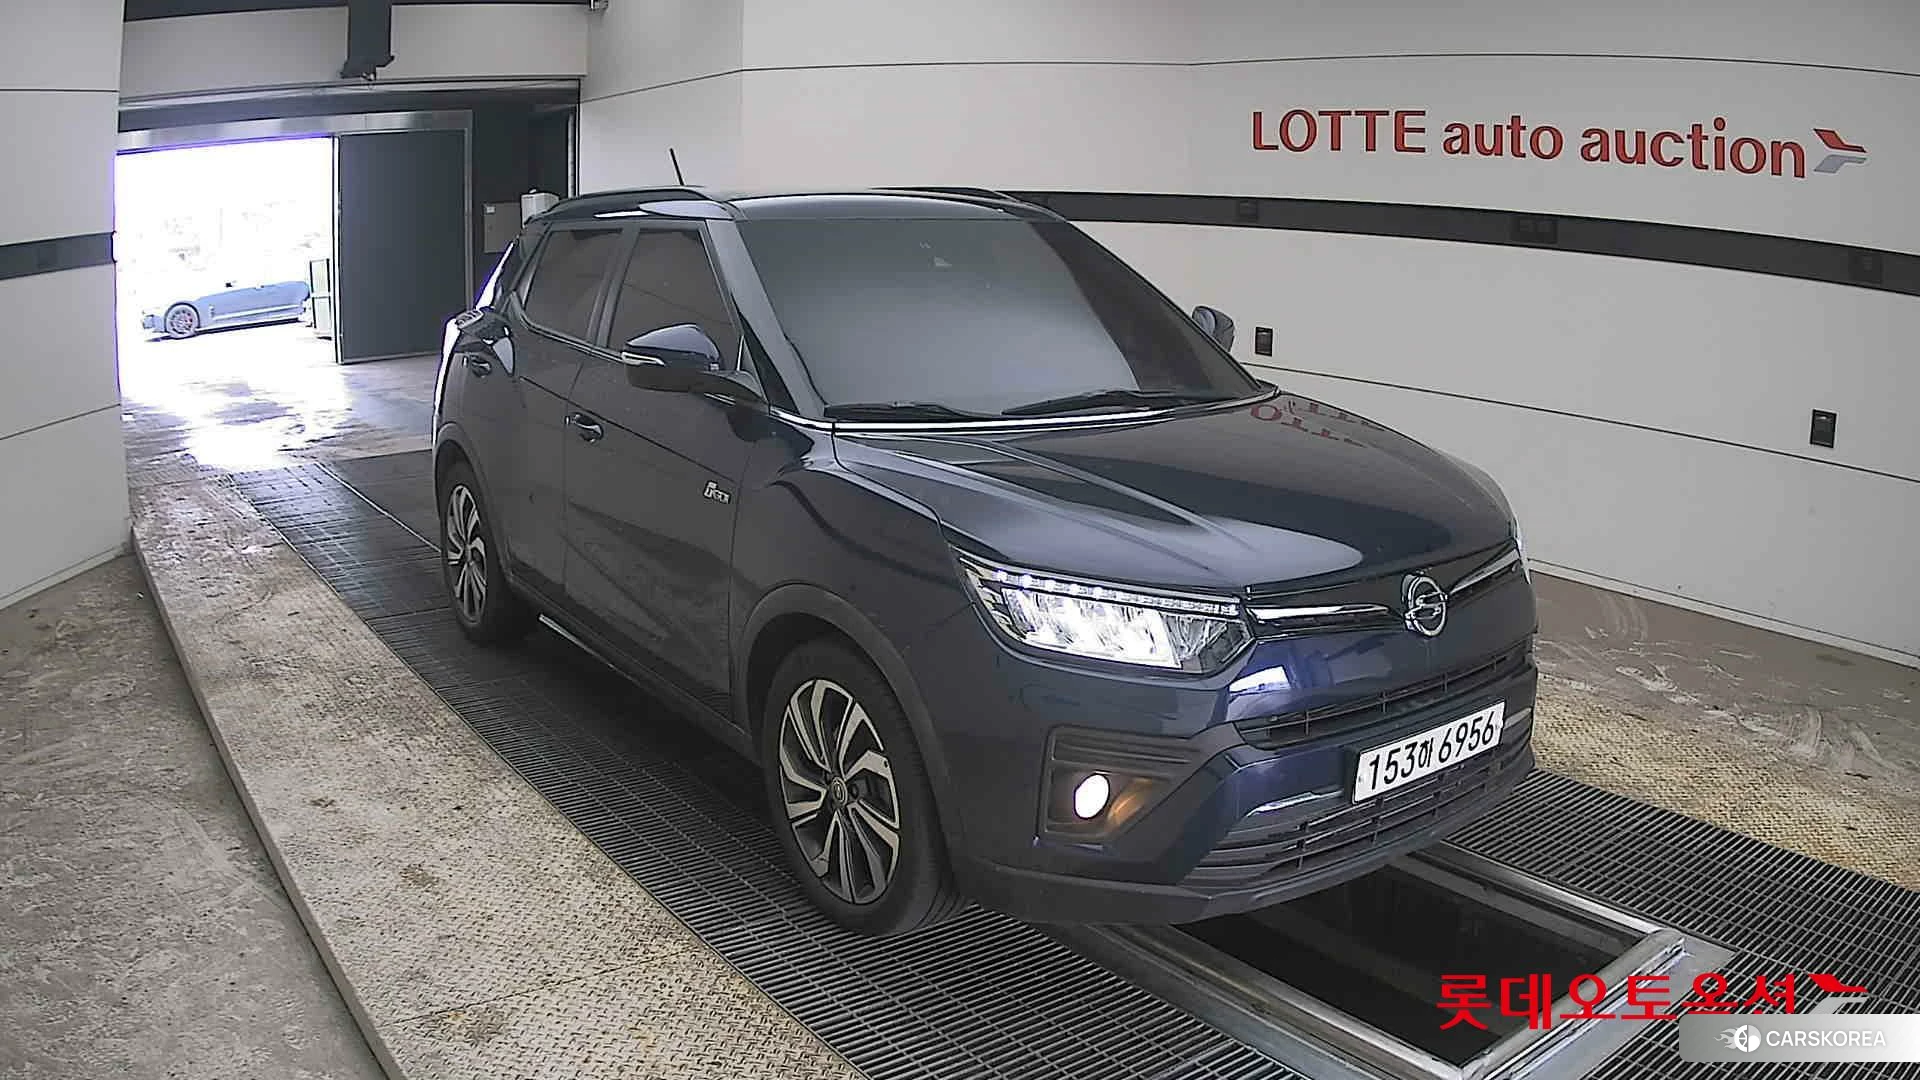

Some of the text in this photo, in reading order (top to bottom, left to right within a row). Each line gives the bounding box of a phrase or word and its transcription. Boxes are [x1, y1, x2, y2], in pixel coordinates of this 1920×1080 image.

[1252, 109, 1806, 179] LOTTE auto auction
[1438, 711, 1495, 763] 6956
